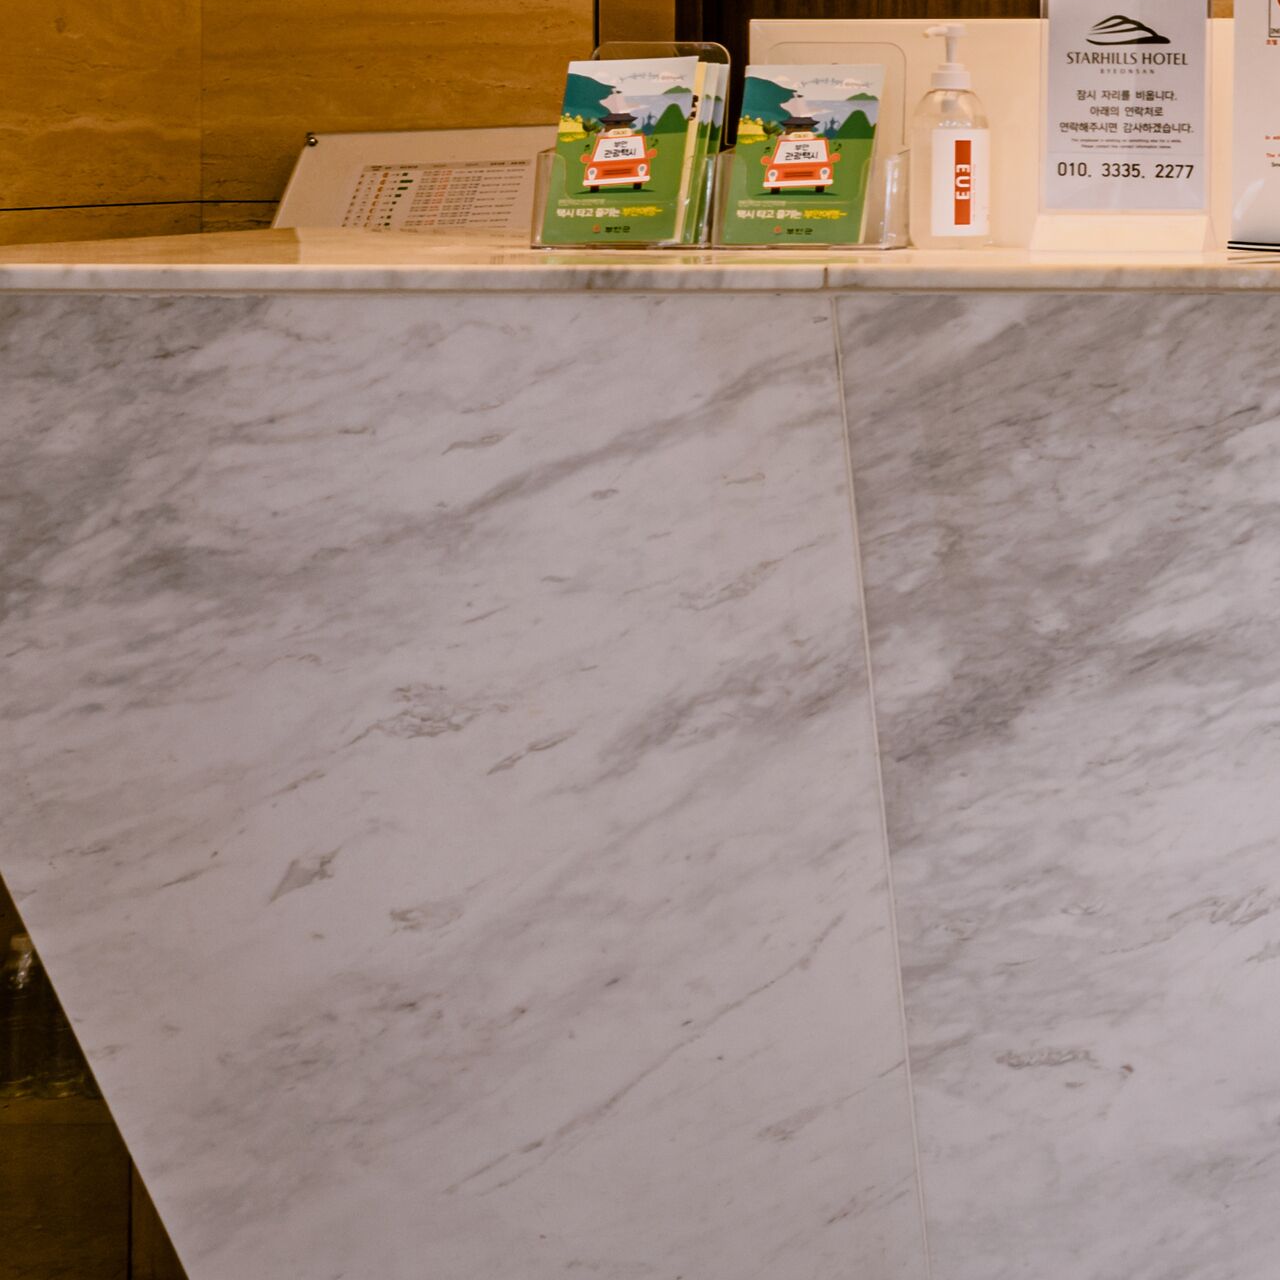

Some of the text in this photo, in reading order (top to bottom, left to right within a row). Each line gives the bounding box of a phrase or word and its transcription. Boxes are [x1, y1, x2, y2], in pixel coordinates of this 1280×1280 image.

[1066, 51, 1189, 65] STARHILLS HOTEL
[1076, 90, 1096, 101] 잠시
[1102, 90, 1131, 101] 자리를
[1090, 106, 1164, 117] 아래의 연락처로
[1059, 122, 1194, 133] 연락해주시면 감사하겠습니다.
[1058, 162, 1194, 179] 010. 3335. 2277
